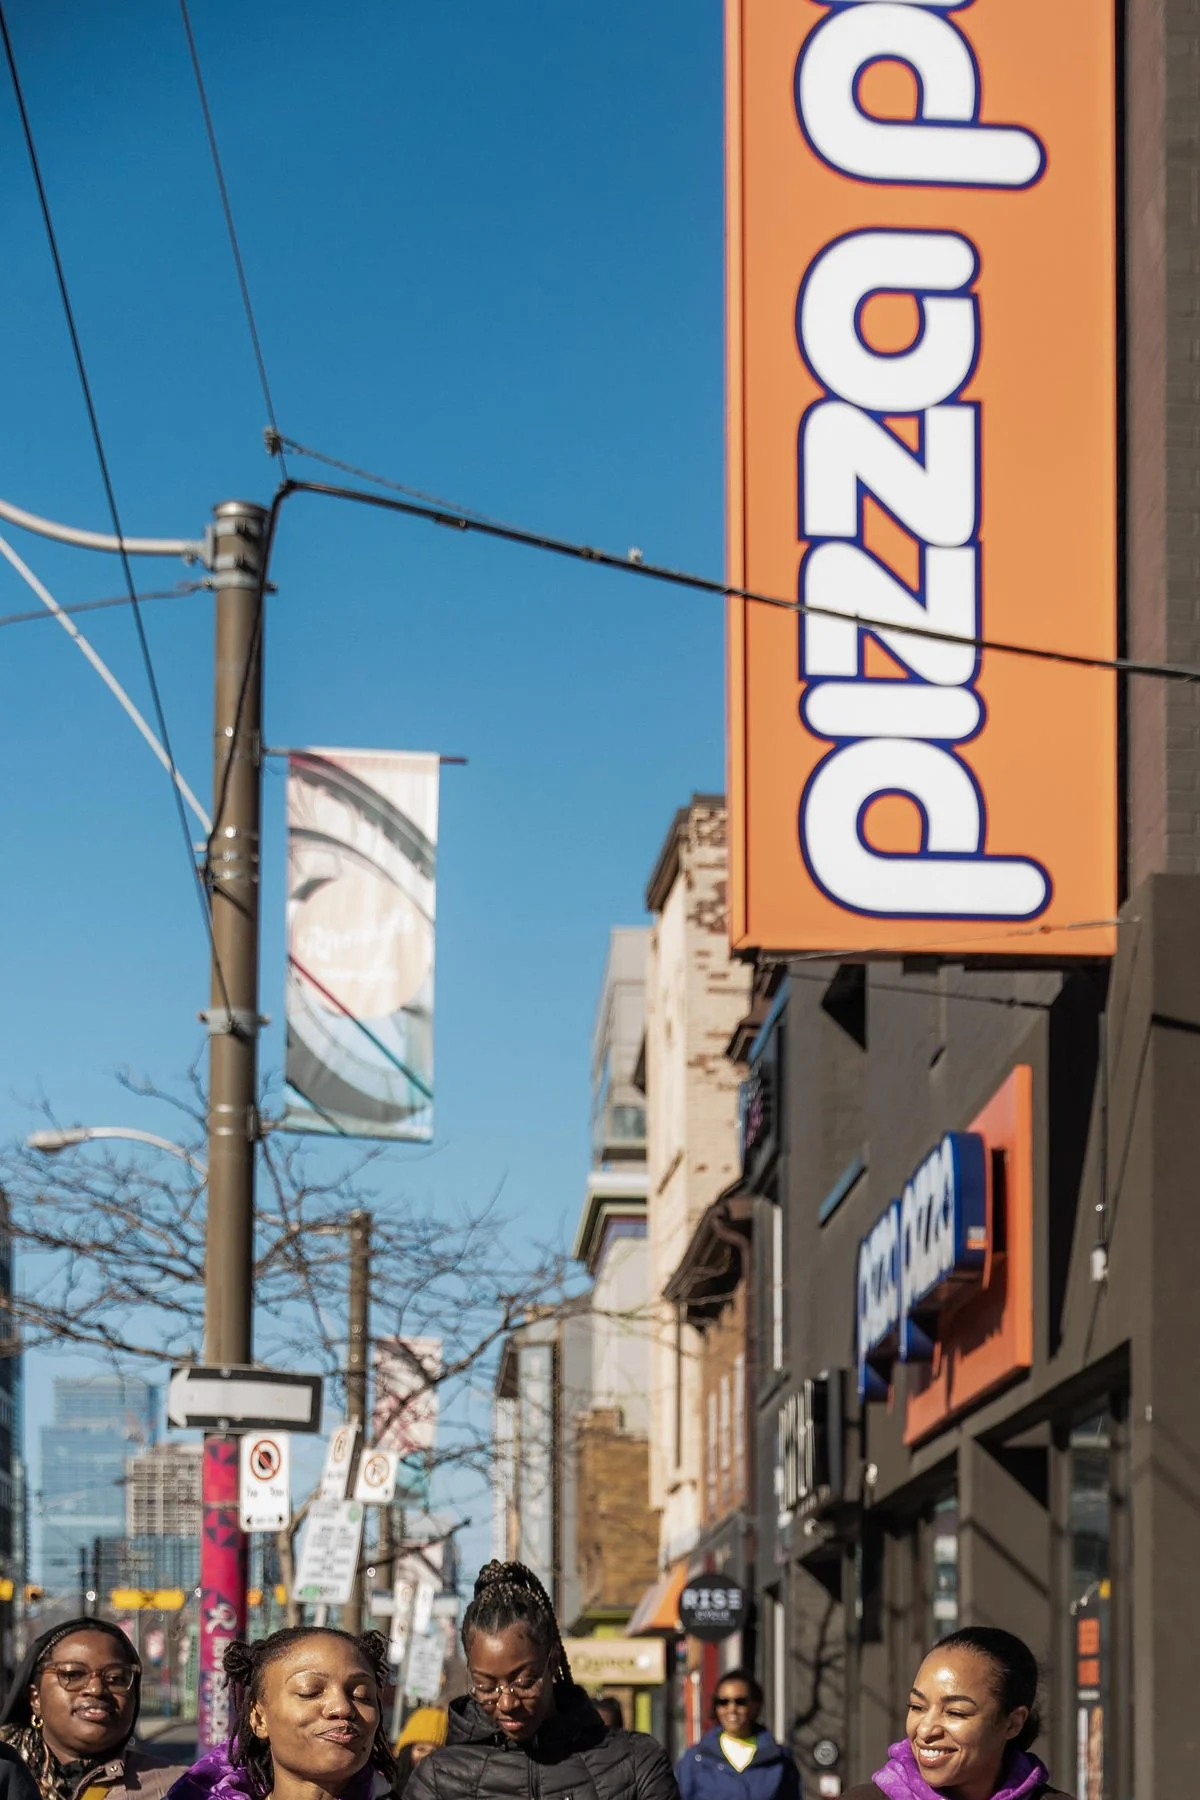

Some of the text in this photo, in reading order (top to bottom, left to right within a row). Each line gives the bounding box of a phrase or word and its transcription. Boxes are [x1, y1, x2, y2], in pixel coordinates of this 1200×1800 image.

[793, 0, 1053, 920] pizza p
[682, 1588, 743, 1609] RISE
